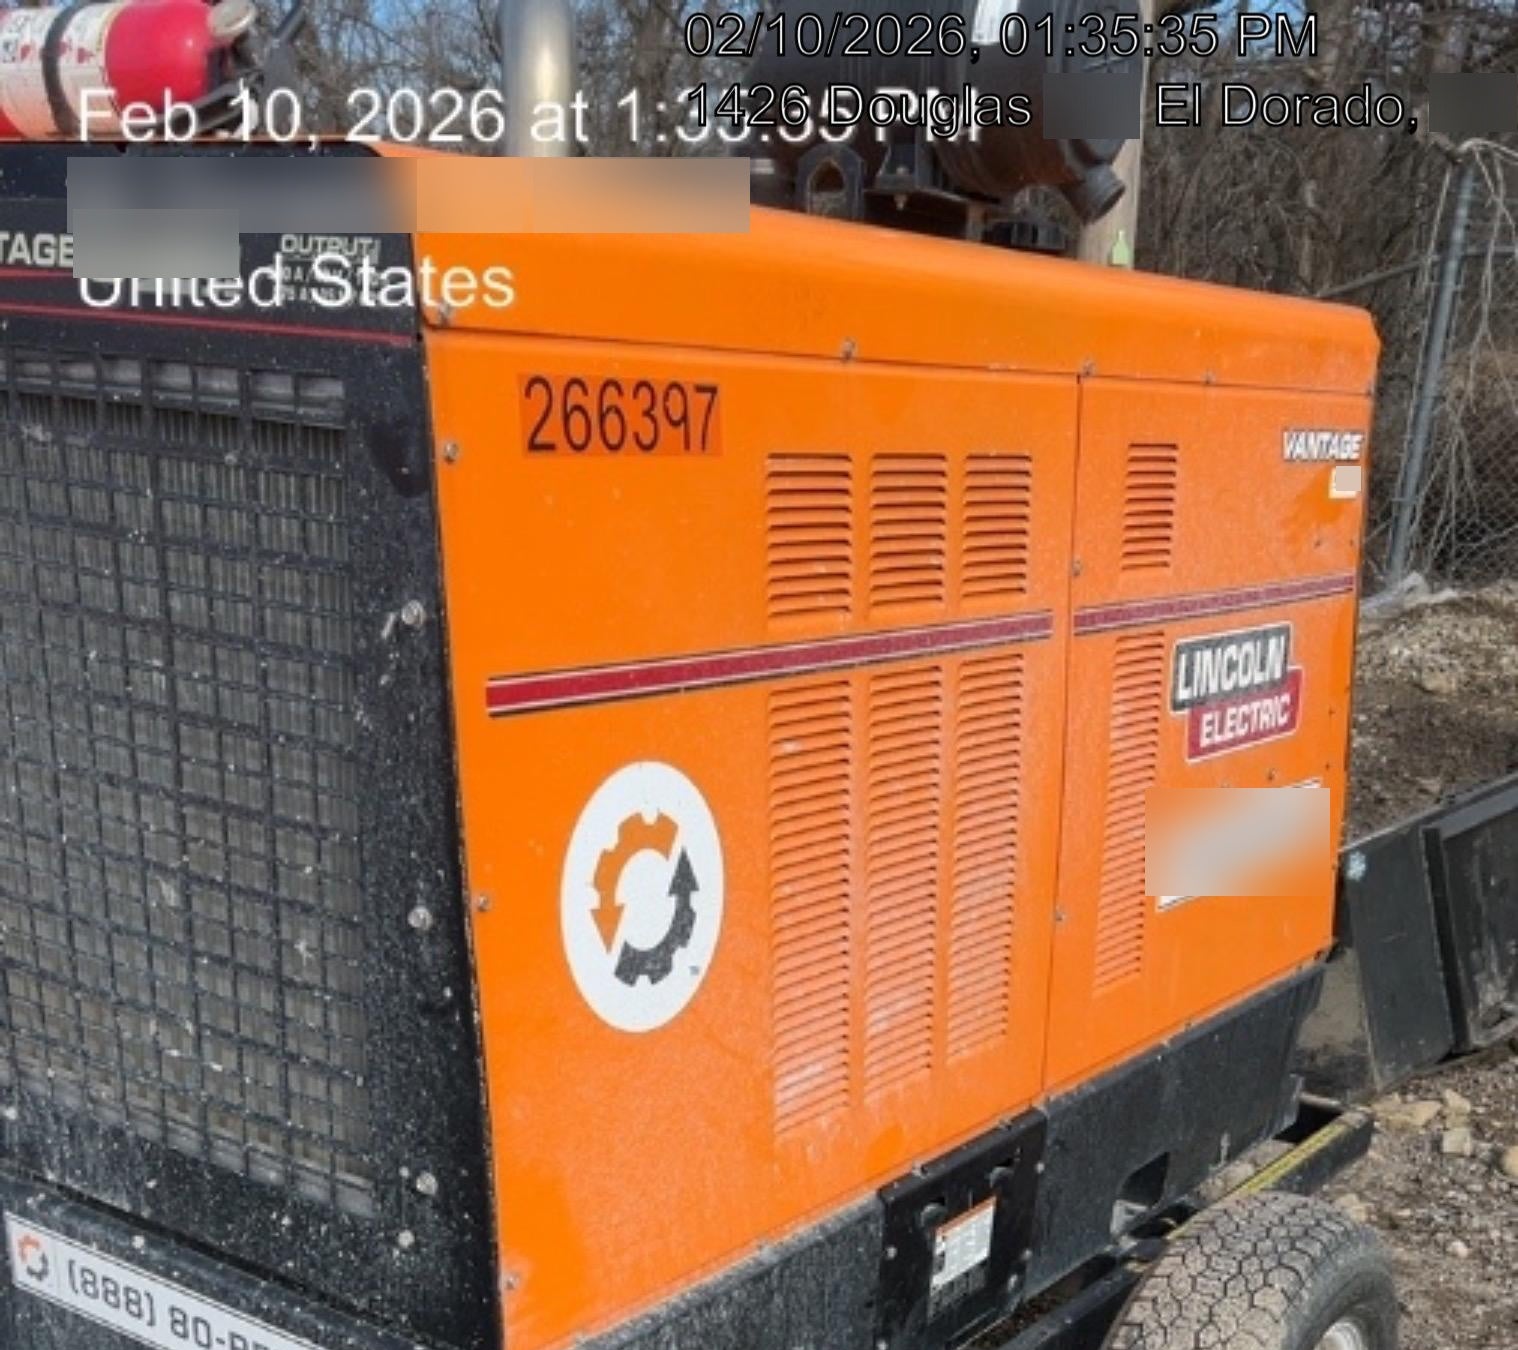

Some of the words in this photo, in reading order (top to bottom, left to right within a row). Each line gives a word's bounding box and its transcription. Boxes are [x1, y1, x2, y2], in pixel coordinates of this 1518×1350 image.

[524, 375, 718, 452] 266397
[1283, 430, 1364, 461] VANTAGE
[1177, 635, 1286, 701] LINCOLN
[1200, 693, 1292, 748] ELECTRIC
[67, 1259, 156, 1327] (888)
